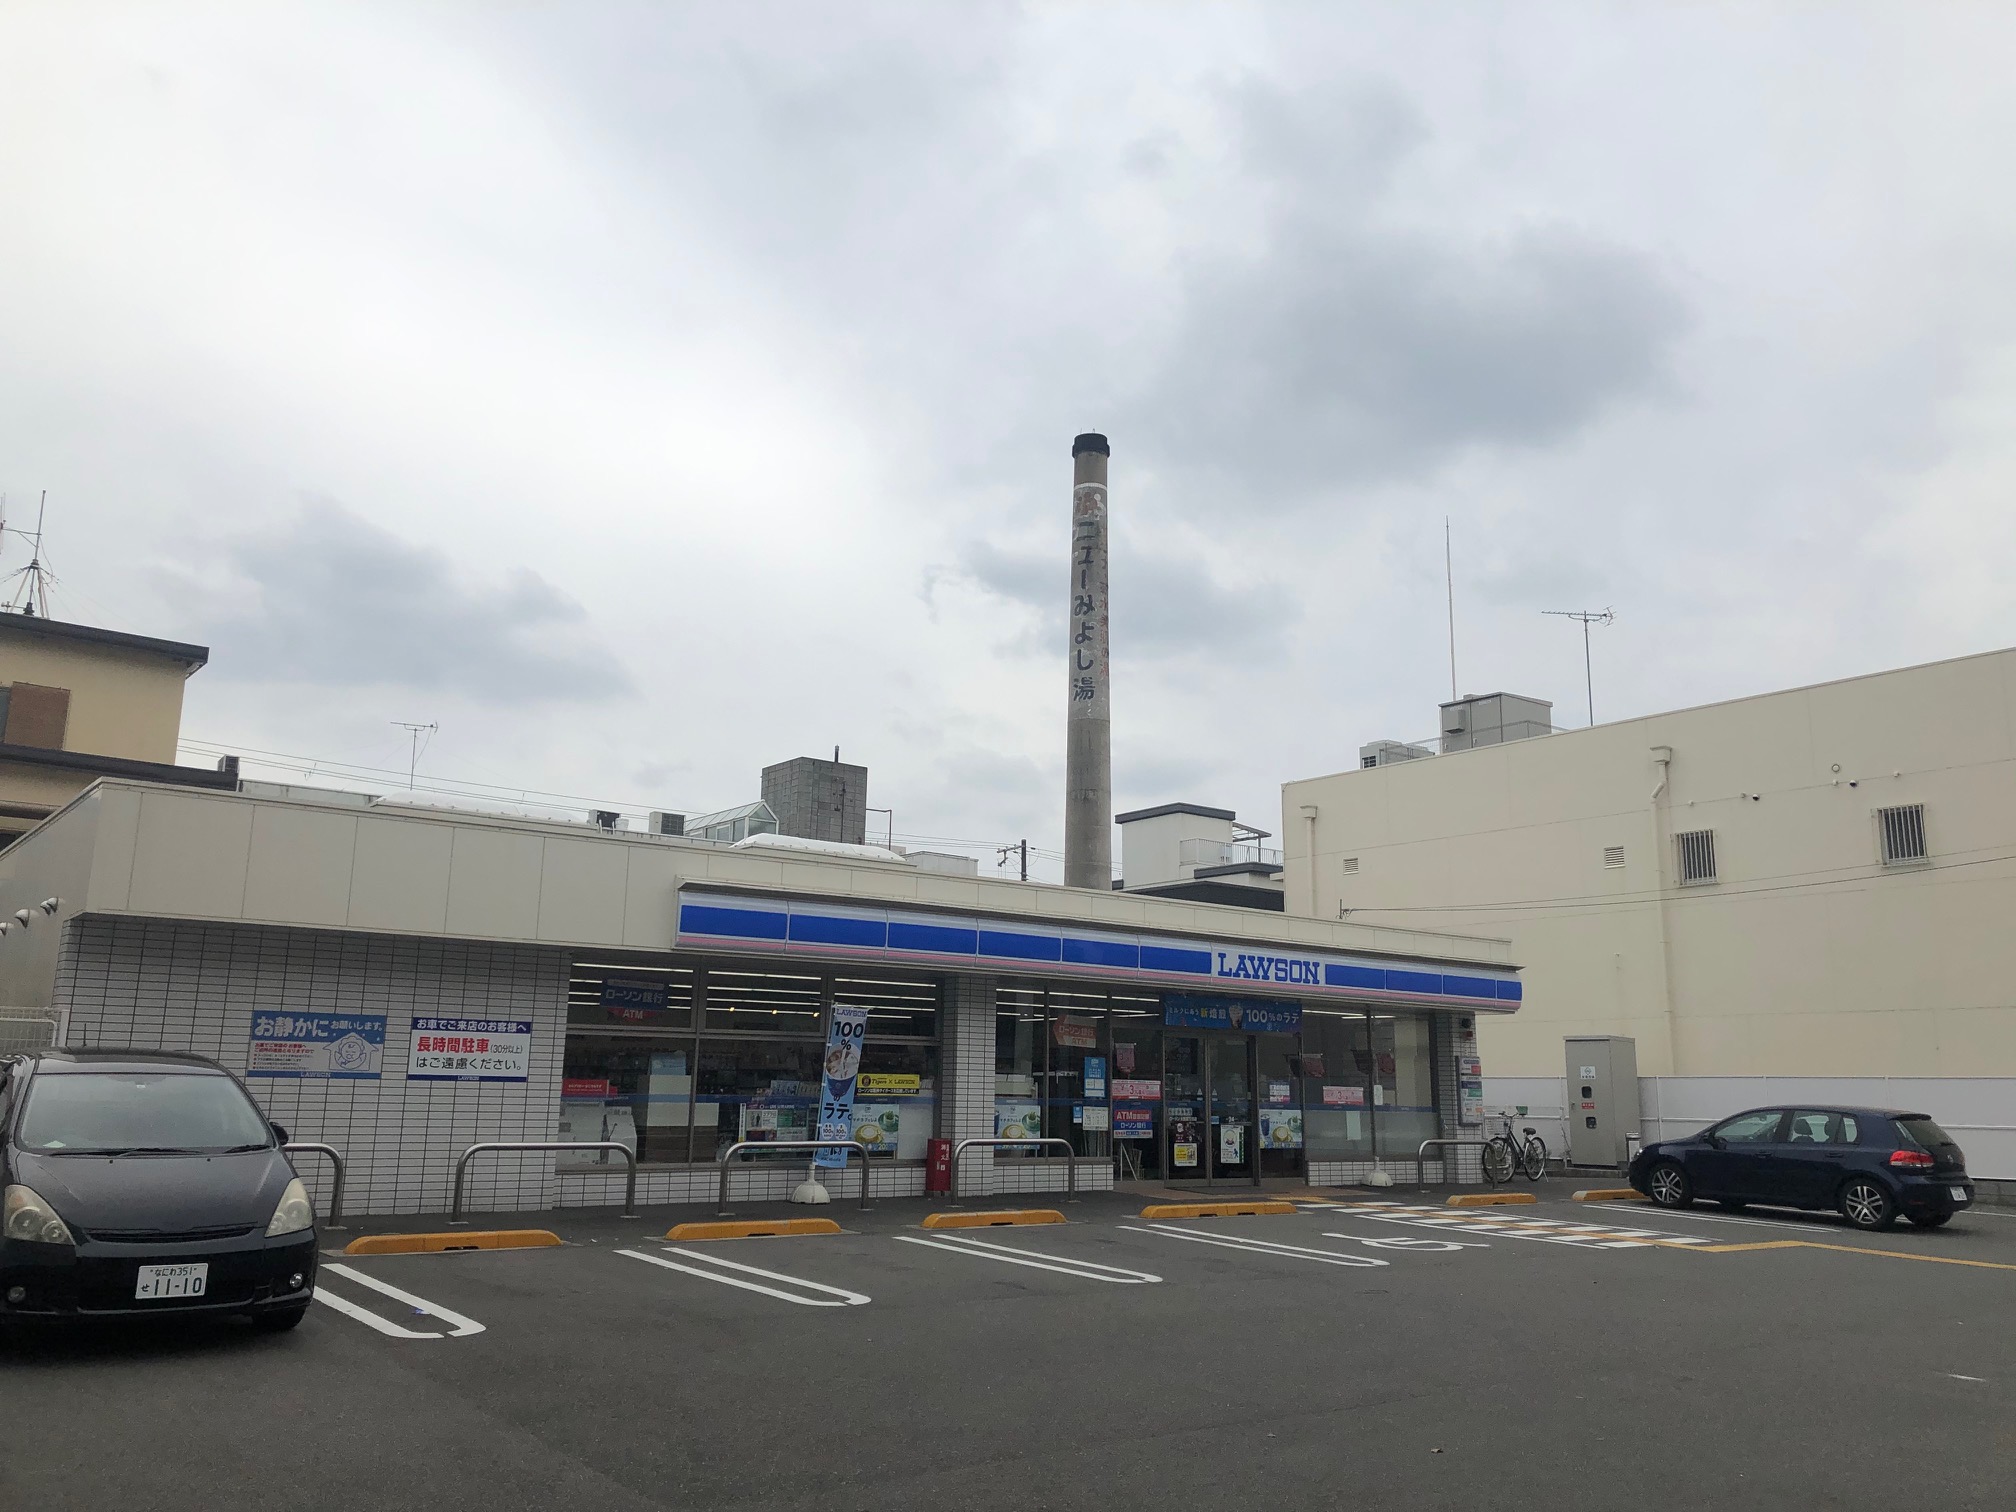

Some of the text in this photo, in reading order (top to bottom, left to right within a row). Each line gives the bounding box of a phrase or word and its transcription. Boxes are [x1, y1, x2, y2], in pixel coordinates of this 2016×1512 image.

[1218, 952, 1320, 985] LAWSON
[605, 989, 663, 1004] ローソン銀行
[622, 1009, 644, 1019] ATM
[836, 1008, 867, 1017] LAWSON
[254, 1016, 383, 1037] お静かに お願いします。
[416, 1019, 527, 1033] お車でご来店のお客様へ
[834, 1020, 864, 1038] 100
[1058, 1025, 1094, 1036] ローソン銀行
[416, 1036, 490, 1054] 長時間駐車
[416, 1056, 522, 1071] はご遠慮ください。
[141, 1277, 203, 1296] せ 11-10
